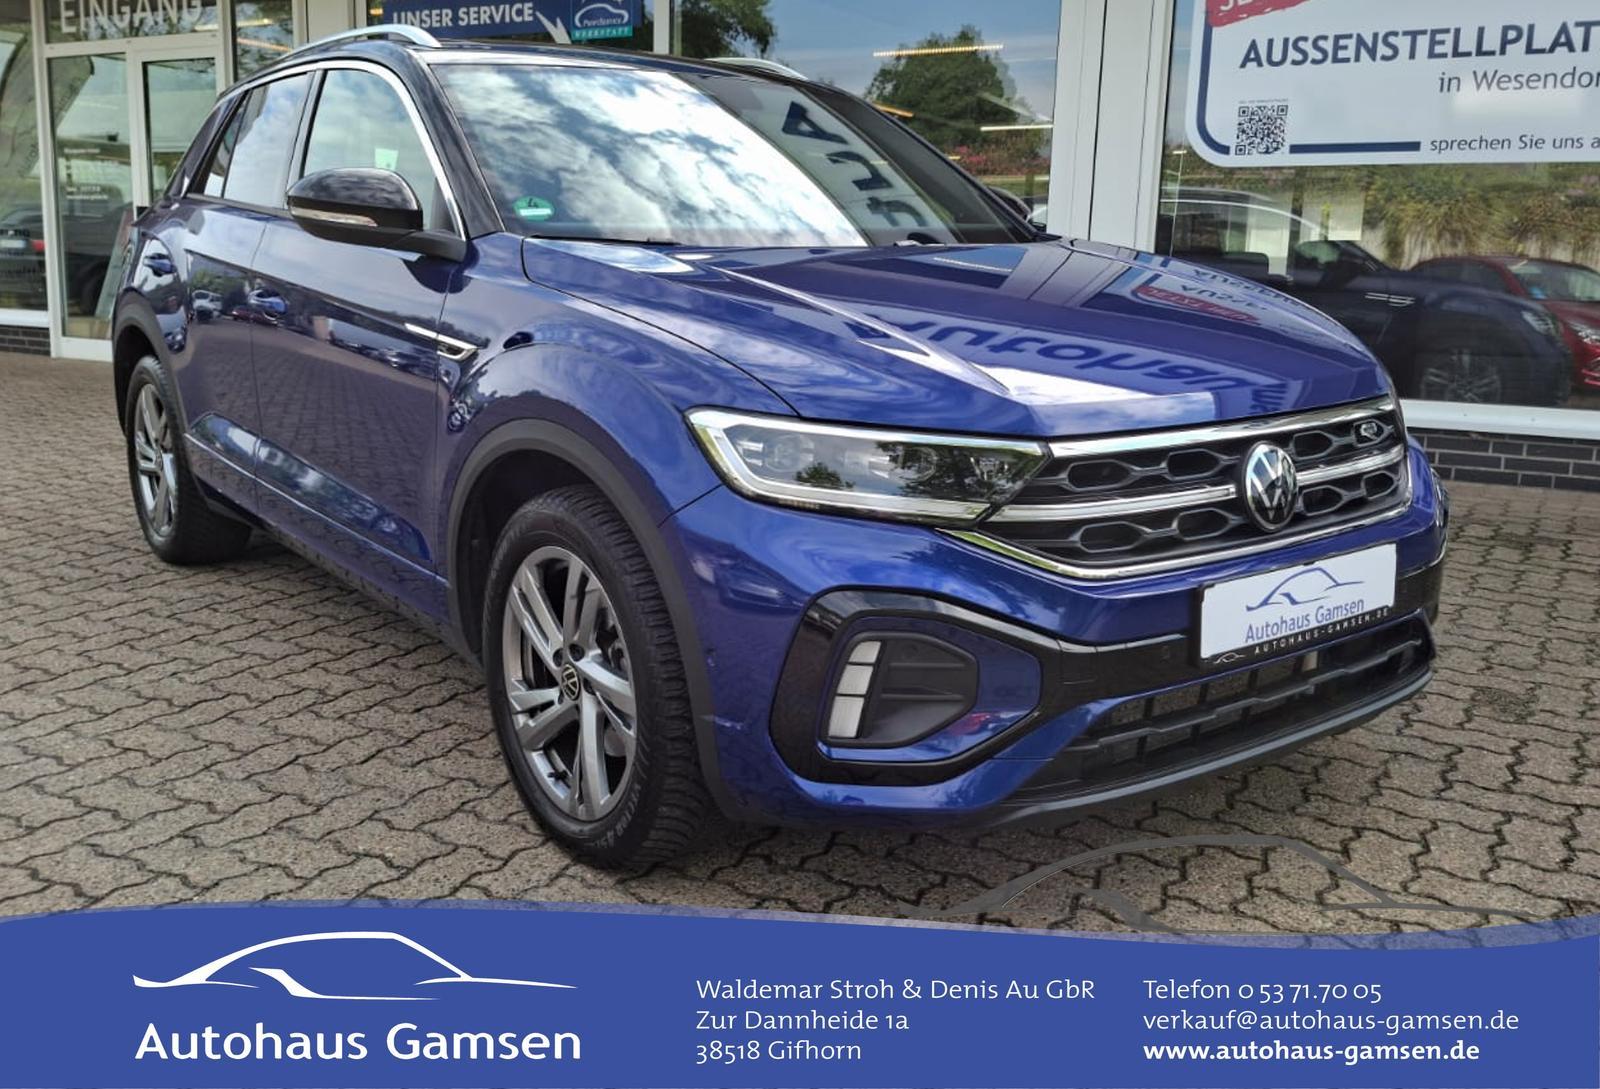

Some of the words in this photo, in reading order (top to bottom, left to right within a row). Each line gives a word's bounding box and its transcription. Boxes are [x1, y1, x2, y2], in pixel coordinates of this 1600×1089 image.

[60, 0, 203, 34] EINGANG
[392, 8, 454, 29] UNSER
[458, 3, 534, 27] SERVICE
[1438, 71, 1462, 94] in
[1429, 136, 1513, 153] sprechen
[1518, 133, 1546, 151] Sie
[1552, 136, 1585, 151] uns
[1245, 613, 1311, 643] Autohaus
[1315, 599, 1365, 624] Gamsen
[1254, 607, 1389, 655] AUTOHAUS-GAMSEN.DE
